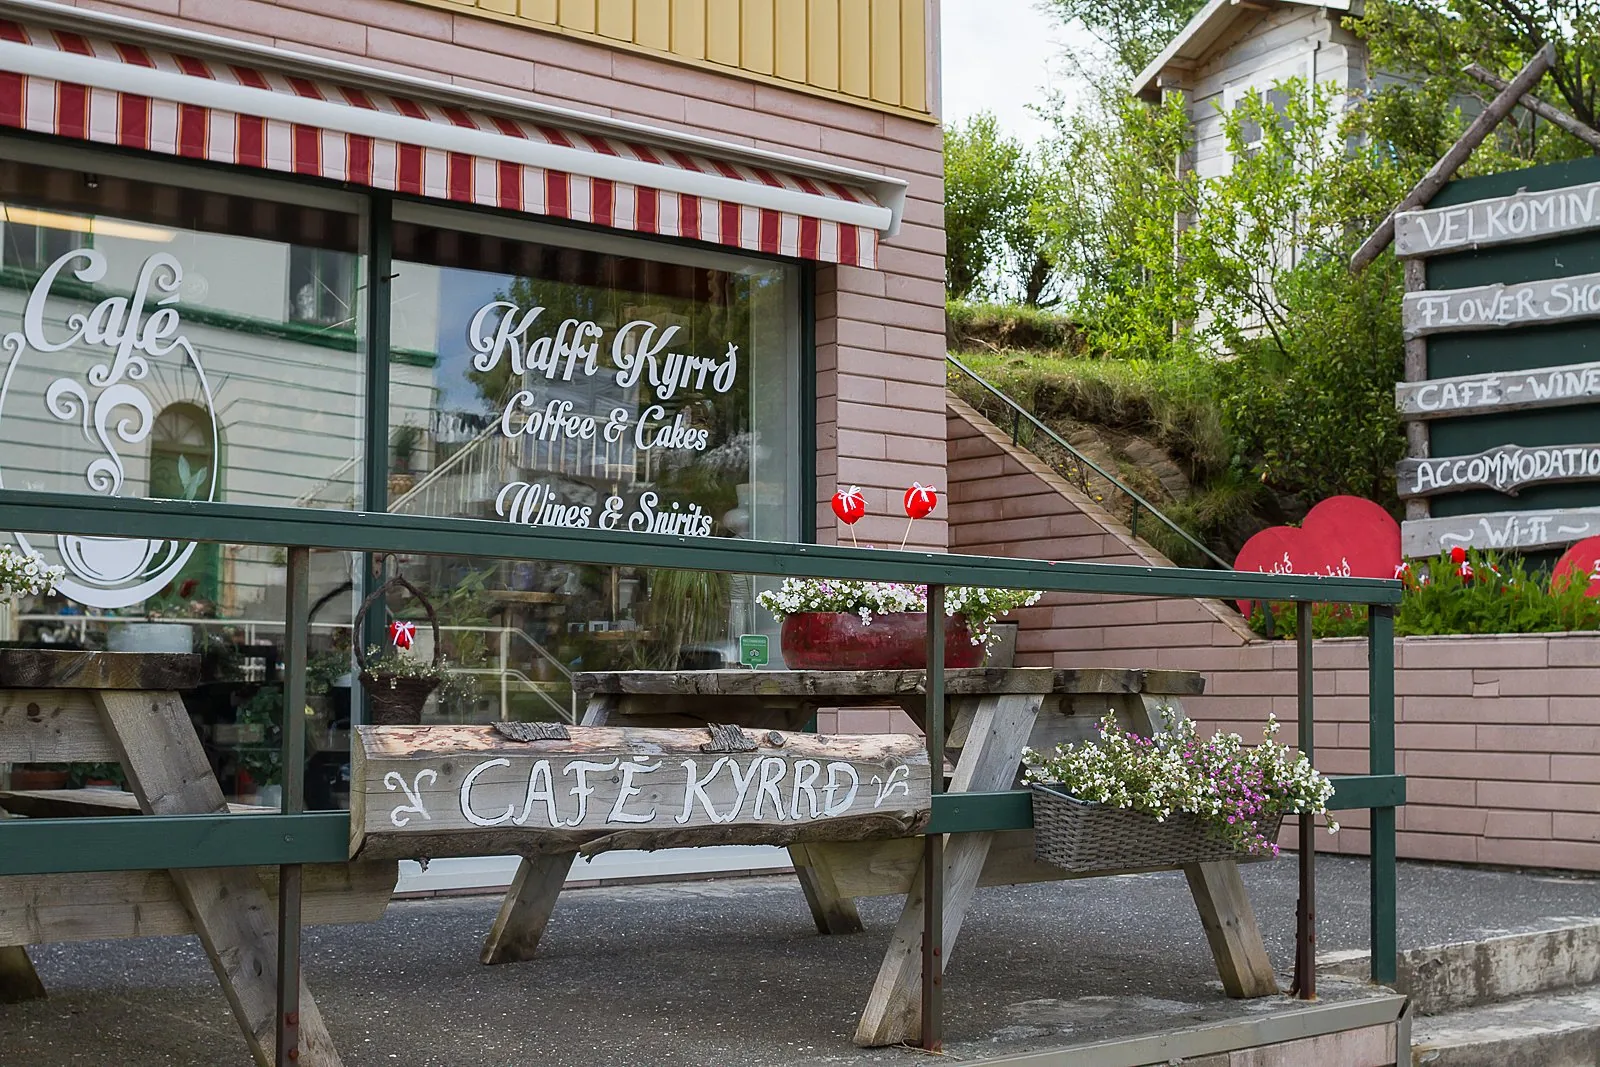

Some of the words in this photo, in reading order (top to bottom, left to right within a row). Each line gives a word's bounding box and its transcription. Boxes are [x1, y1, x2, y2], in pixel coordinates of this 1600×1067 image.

[25, 248, 184, 387] Café
[1416, 289, 1540, 326] FLOWER
[469, 301, 603, 382] Kaffi
[612, 320, 738, 400] Kyrrð
[1417, 377, 1501, 411] CAFÉ
[1526, 368, 1600, 400] WINE
[501, 390, 596, 442] Coffee
[603, 408, 628, 443] &
[635, 405, 708, 451] Cakes
[495, 481, 593, 529] Wines
[598, 496, 624, 530] &
[459, 756, 663, 828] CAFÉ
